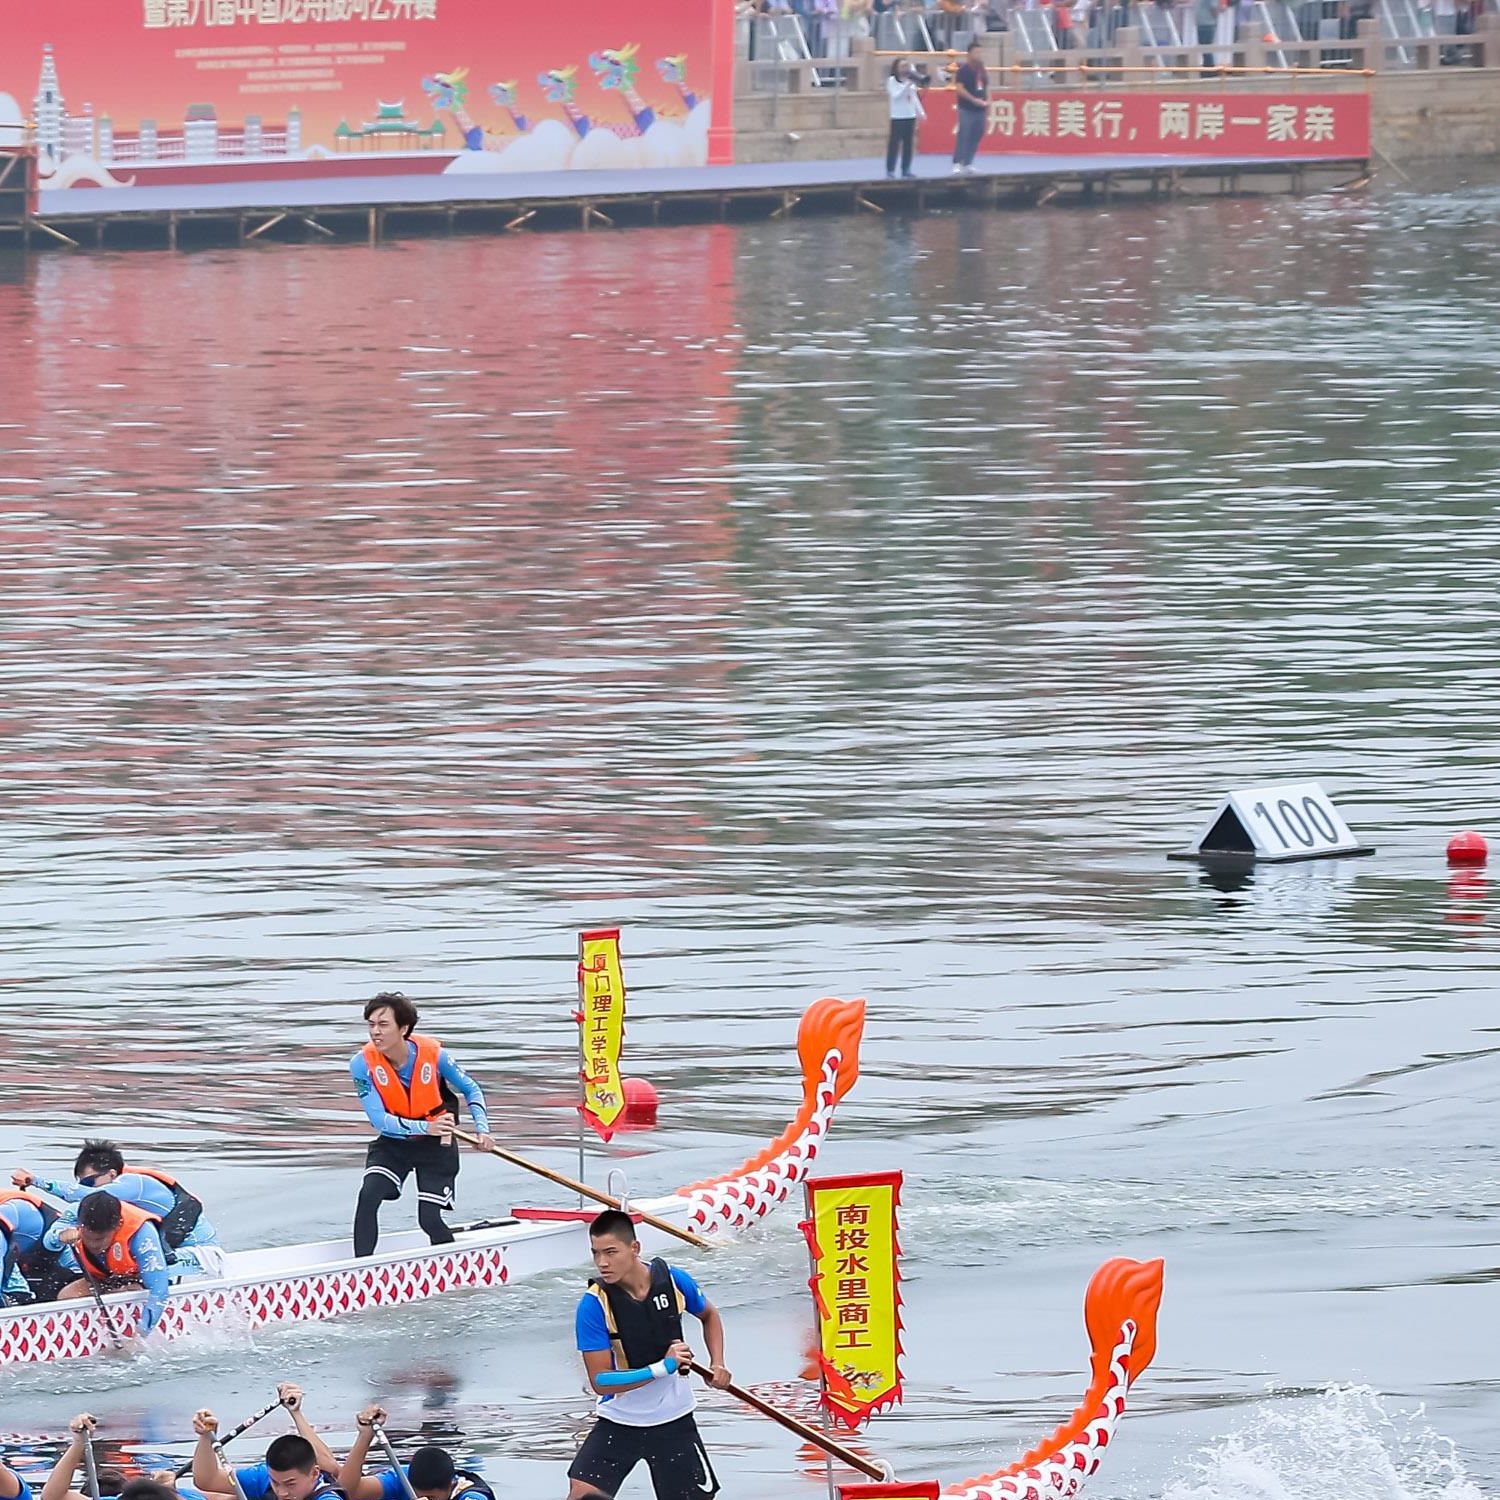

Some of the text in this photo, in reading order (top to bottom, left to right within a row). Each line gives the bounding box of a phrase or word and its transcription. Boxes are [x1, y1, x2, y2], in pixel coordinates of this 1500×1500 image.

[952, 99, 1335, 141] 舟集美行，两岸一家亲
[1254, 796, 1339, 849] 100
[591, 954, 612, 1075] 厦门理工学院
[652, 1293, 669, 1310] 16
[834, 1203, 872, 1349] 南投水里商工
